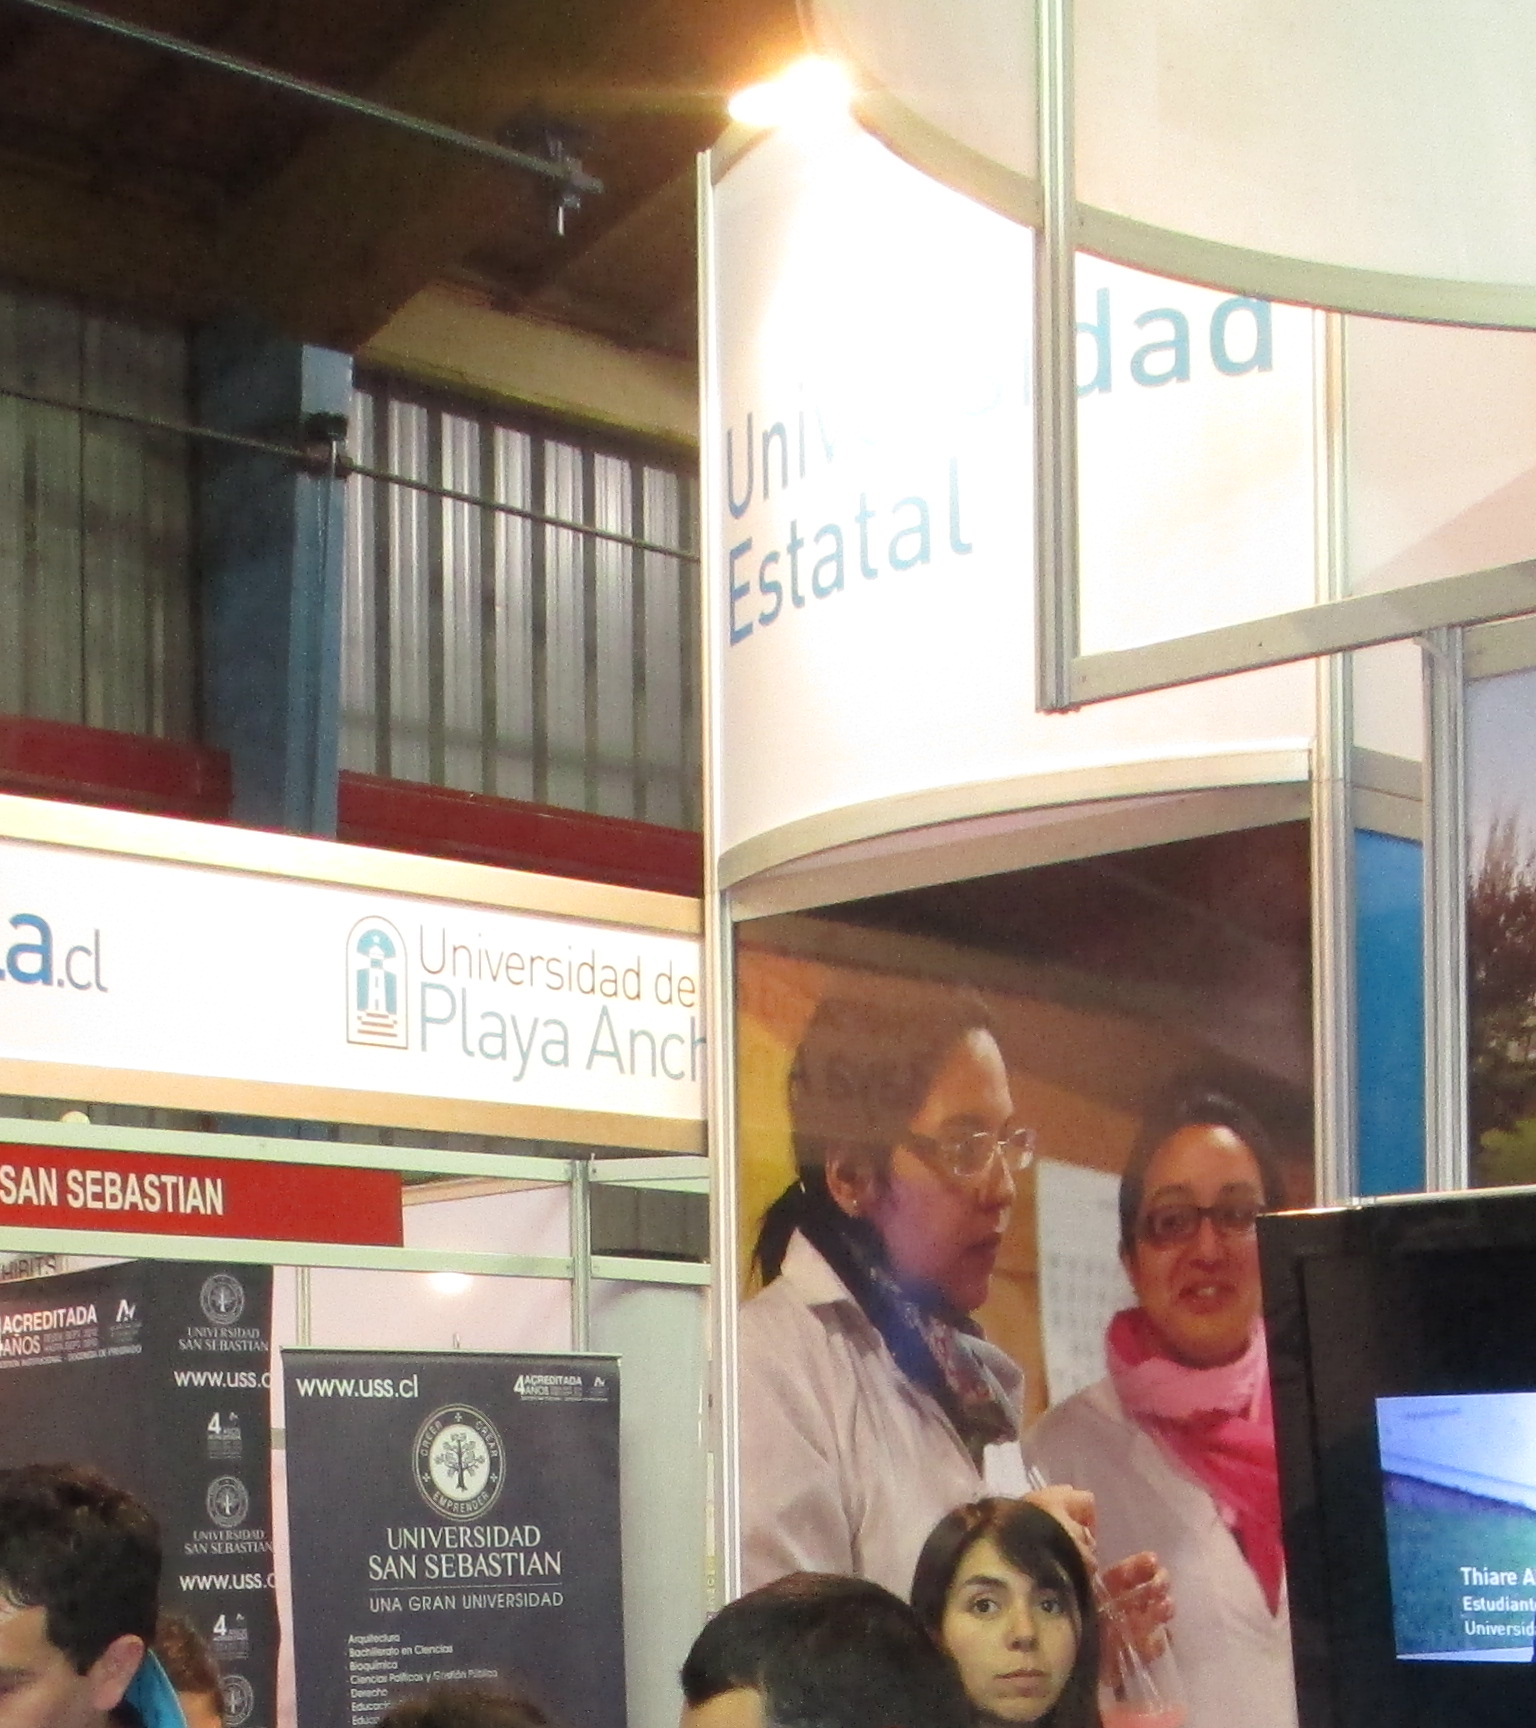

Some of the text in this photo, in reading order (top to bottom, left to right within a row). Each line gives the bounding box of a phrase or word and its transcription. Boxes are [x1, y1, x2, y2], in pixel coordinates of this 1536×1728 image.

[727, 456, 975, 648] Estatal
[419, 923, 696, 1009] Universidad de
[420, 981, 706, 1083] Playa Anch
[65, 1168, 225, 1216] SEBASTIAN
[2, 1304, 99, 1334] ACREDITADA
[173, 1370, 272, 1388] www.uss.c
[295, 1373, 420, 1399] www.uss.cl
[387, 1524, 541, 1550] UNIVERSIDAD
[368, 1550, 562, 1580] SAN SEBASTIAN
[1460, 1566, 1518, 1587] Thiare
[179, 1572, 276, 1591] www.uss.c
[369, 1592, 564, 1613] UNA GRAN UNIVERSIDAD
